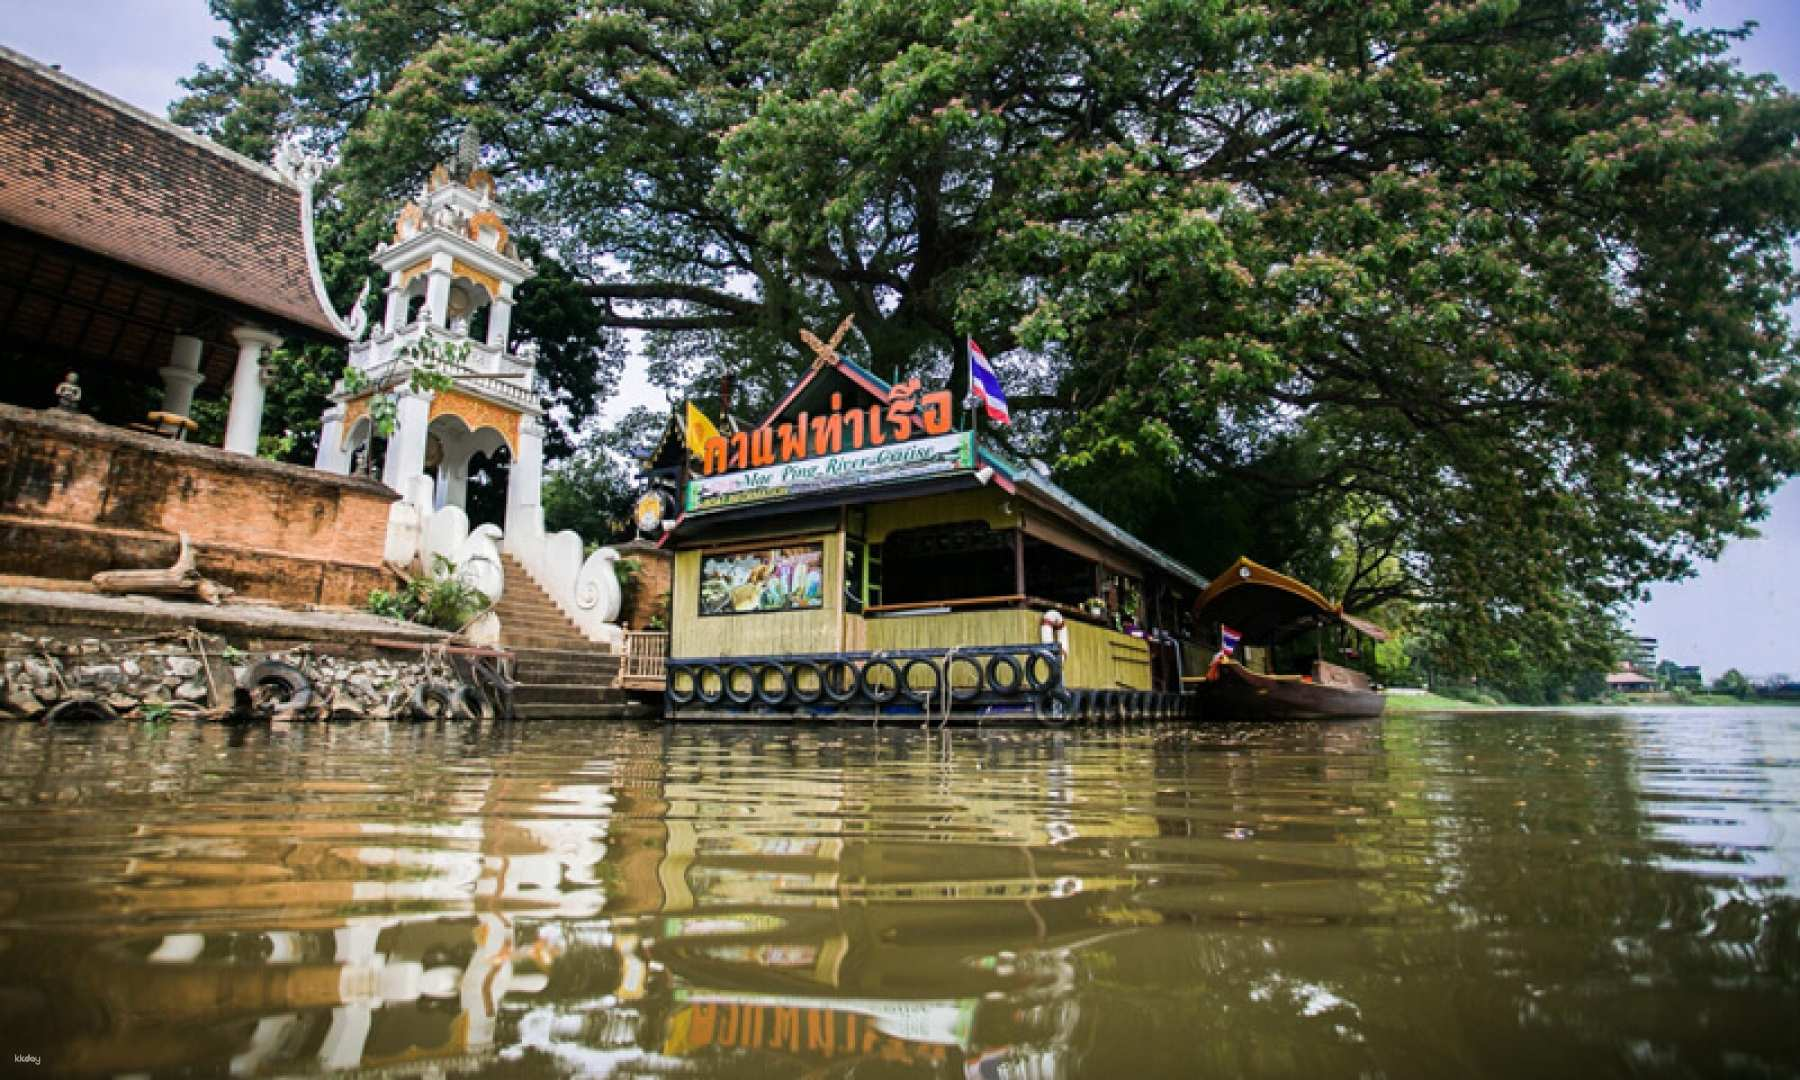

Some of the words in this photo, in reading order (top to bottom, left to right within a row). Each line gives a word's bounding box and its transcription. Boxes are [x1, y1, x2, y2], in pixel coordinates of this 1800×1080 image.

[703, 378, 953, 476] กาแฟท่าเรือ
[826, 455, 865, 475] River
